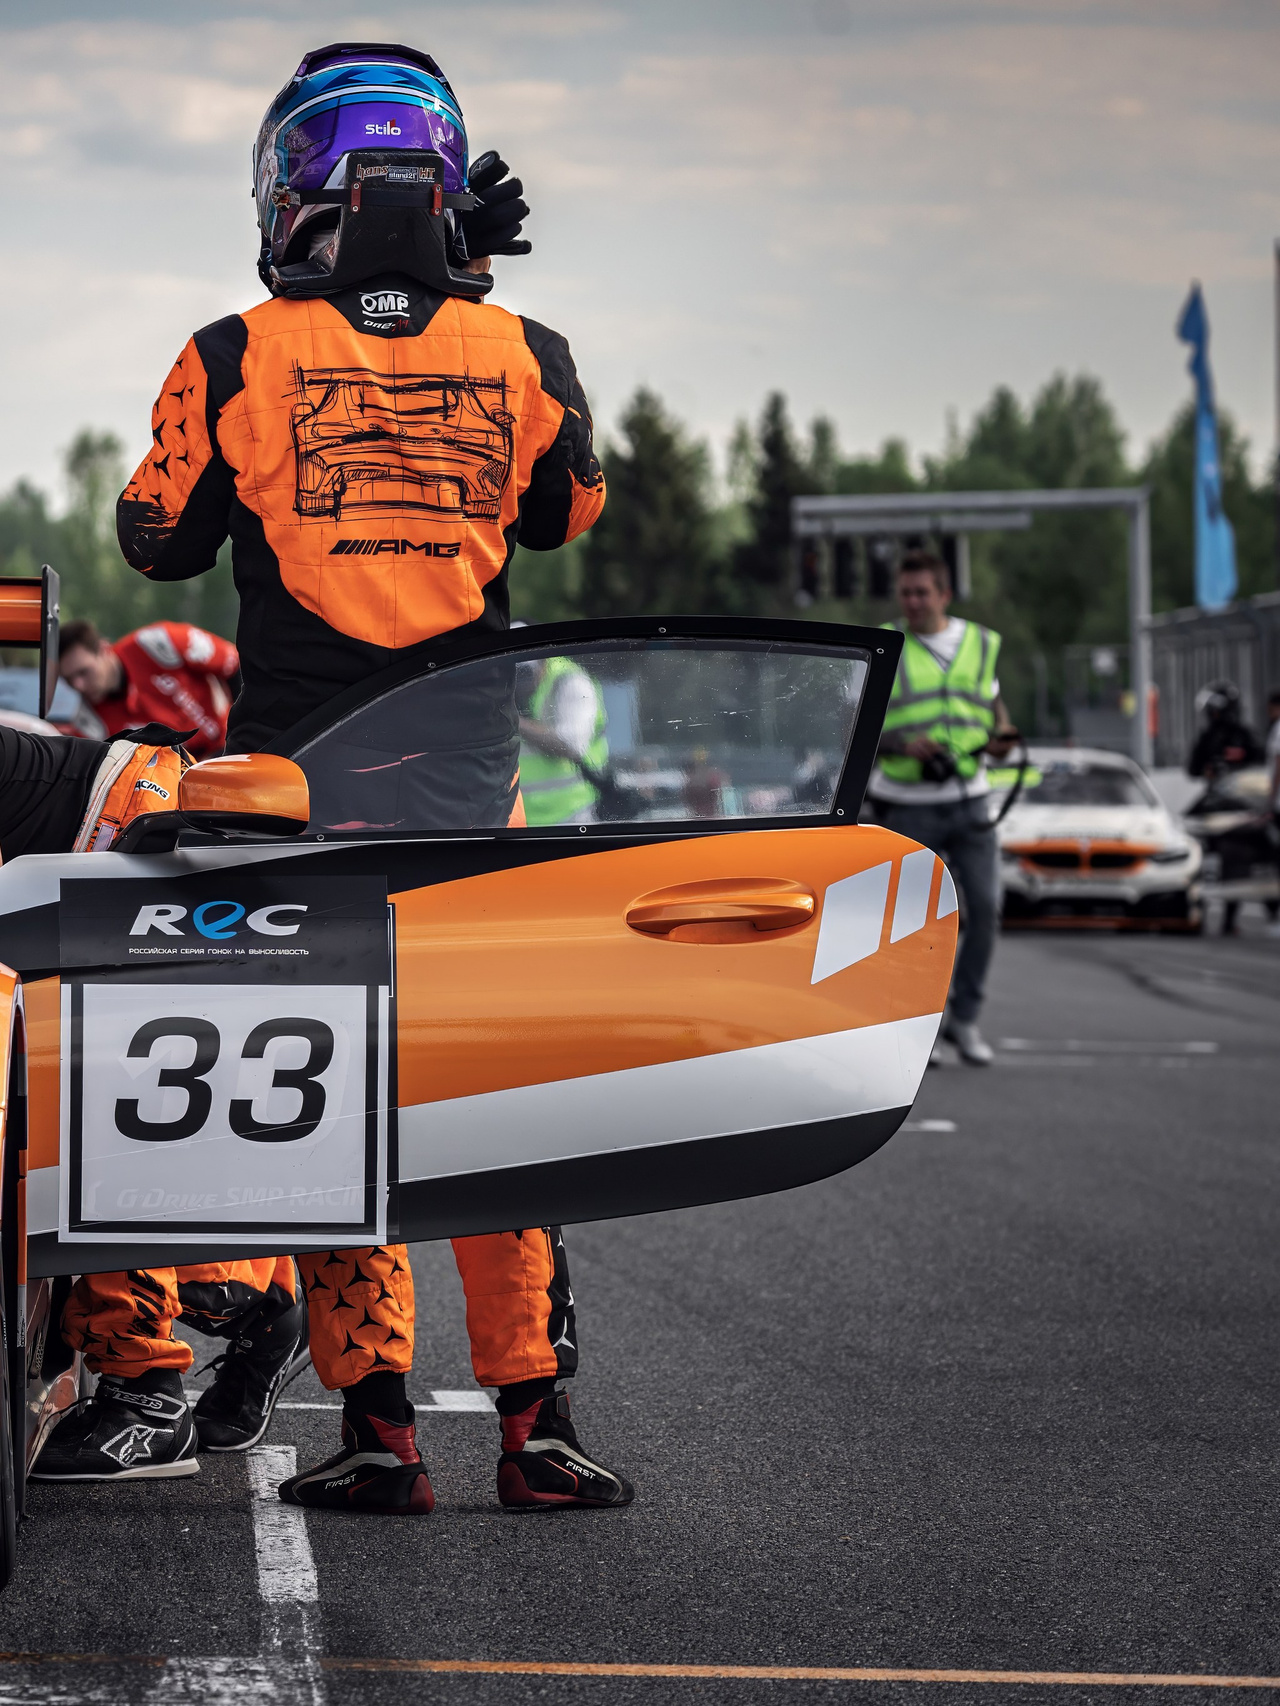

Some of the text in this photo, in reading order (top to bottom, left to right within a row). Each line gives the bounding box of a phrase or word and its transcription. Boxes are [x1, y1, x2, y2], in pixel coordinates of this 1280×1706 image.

[365, 121, 402, 136] Stilo
[356, 164, 389, 180] hans
[360, 294, 409, 312] OMP
[372, 539, 461, 558] AMG
[135, 780, 168, 798] ACING
[129, 947, 177, 955] РОССИЙСКАЯ
[114, 1016, 334, 1142] 33
[566, 1461, 596, 1479] FIRST
[325, 1474, 357, 1489] FIRST
